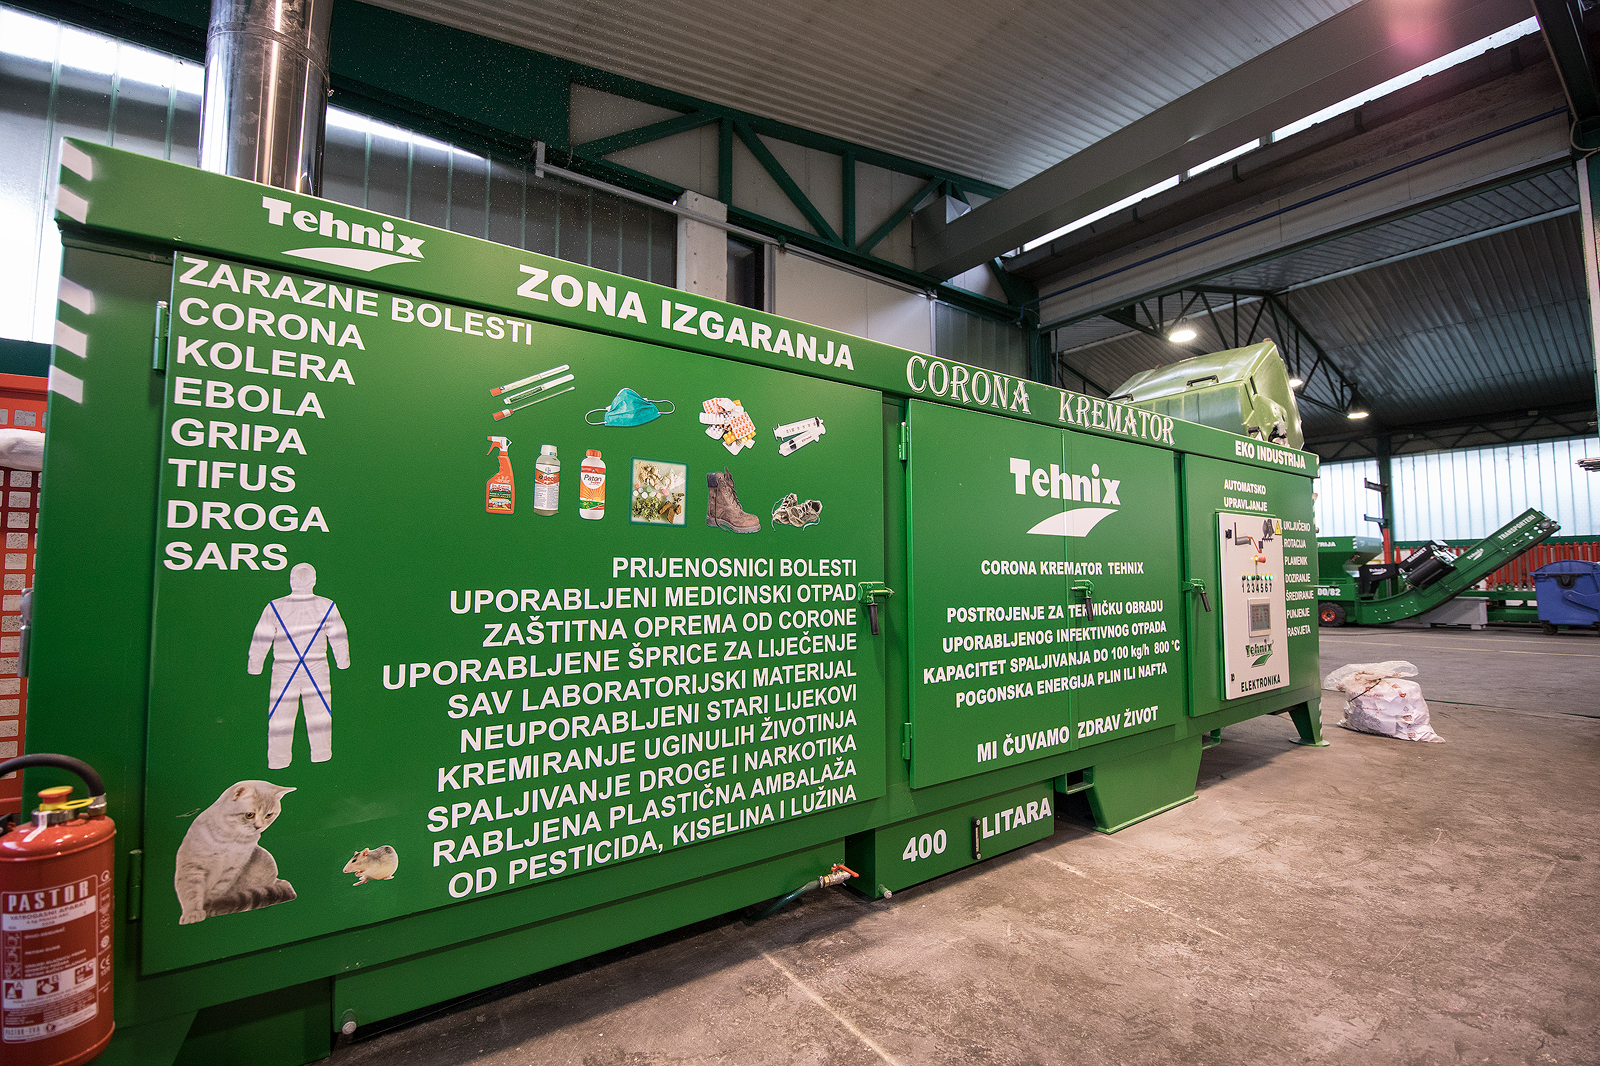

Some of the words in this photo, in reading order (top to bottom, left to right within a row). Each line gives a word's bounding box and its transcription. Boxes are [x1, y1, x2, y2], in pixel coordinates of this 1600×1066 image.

[262, 196, 425, 258] Tehnix
[179, 257, 378, 317] ZARAZNE
[392, 297, 531, 345] BOLESTI
[517, 264, 647, 323] ZONA
[662, 299, 854, 370] IZGARANJA
[179, 298, 365, 350] CORONA
[177, 336, 355, 385] KOLERA
[174, 377, 325, 418] EBOLA
[907, 355, 1031, 414] CORONA
[1058, 391, 1175, 446] KREMATOR
[171, 418, 307, 455] GRIPA
[1236, 440, 1254, 458] EKO
[1257, 445, 1306, 469] INDUSTRIJA
[168, 459, 295, 492] TIFUS
[1010, 458, 1121, 505] Tehnix
[1224, 479, 1266, 494] AUTOMATSKO
[167, 500, 329, 532] DROGA
[1224, 497, 1267, 512] UPRAVLJANJE
[1284, 539, 1306, 548] ROTACIJA
[1498, 514, 1537, 541] TRANSPORTERI
[163, 542, 287, 570] SARS
[613, 557, 773, 578] PRIJENOSNICI
[781, 559, 856, 576] BOLESTI
[981, 560, 1037, 575] CORONA
[1041, 562, 1102, 575] KREMATOR
[1108, 562, 1144, 574] TEHNIX
[1285, 556, 1307, 565] PLAMENIK
[1286, 574, 1310, 583] DOZIRANJE
[451, 588, 656, 614] UPORABLJENI
[666, 585, 790, 606] MEDICINSKI
[797, 584, 856, 602] OTPAD
[948, 606, 1044, 622] POSTROJENJE
[1048, 605, 1064, 619] ZA
[1126, 600, 1163, 614] OBRADU
[1287, 608, 1310, 618] PUNJENJE
[483, 616, 627, 647] ZAŠTITNA
[635, 614, 737, 638] OPREMA
[743, 612, 772, 631] OD
[779, 609, 856, 629] CORONE
[943, 630, 1053, 653] UPORABLJENOG
[1057, 624, 1129, 642] INFEKTIVNOG
[1132, 621, 1166, 635] OTPADA
[1288, 625, 1311, 636] RASVJETA
[383, 650, 619, 689] UPORABLJENE
[628, 643, 717, 669] ŠPRICE
[724, 641, 752, 661] ZA
[758, 631, 856, 657] LIJEČENJE
[924, 660, 1006, 684] KAPACITET
[1011, 651, 1091, 673] SPALJIVANJA
[1094, 649, 1108, 662] DO
[1112, 646, 1128, 660] 100
[1131, 644, 1149, 659] kg/h
[1155, 641, 1169, 654] 800
[1172, 640, 1180, 651] °C
[1246, 639, 1272, 657] Tehnix
[448, 690, 513, 718] SAV
[523, 670, 745, 711] LABORATORIJSKI
[753, 660, 856, 687] MATERIJAL
[956, 683, 1034, 708] POGONSKA
[1037, 674, 1095, 694] ENERGIJA
[1098, 669, 1121, 685] PLIN
[1124, 667, 1135, 680] ILI
[1139, 663, 1167, 678] NAFTA
[1241, 674, 1281, 692] ELEKTRONIKA
[461, 703, 702, 756] NEUPORABLJENI
[707, 695, 771, 721] STARI
[775, 684, 856, 712] LIJEKOVI
[978, 741, 997, 762] MI
[1003, 727, 1069, 756] ČUVAMO
[1078, 714, 1120, 738] ZDRAV
[1124, 706, 1158, 727] ŽIVOT
[438, 741, 635, 792] KREMIRANJE
[645, 724, 753, 759] UGINULIH
[761, 710, 857, 741] ŽIVOTINJA
[427, 774, 630, 835] SPALJIVANJE
[640, 757, 725, 792] DROGE
[733, 755, 737, 774] I
[745, 734, 856, 772] NARKOTIKA
[433, 803, 601, 869] RABLJENA
[610, 782, 746, 832] PLASTIČNA
[750, 757, 856, 803] AMBALAŽA
[903, 830, 946, 862] 400
[983, 798, 1052, 839] LITARA
[449, 867, 496, 898] OD
[508, 832, 664, 885] PESTICIDA,
[673, 804, 774, 846] KISELINA
[780, 800, 784, 818] I
[792, 785, 856, 816] LUŽINA
[8, 881, 89, 912] PASTOR
